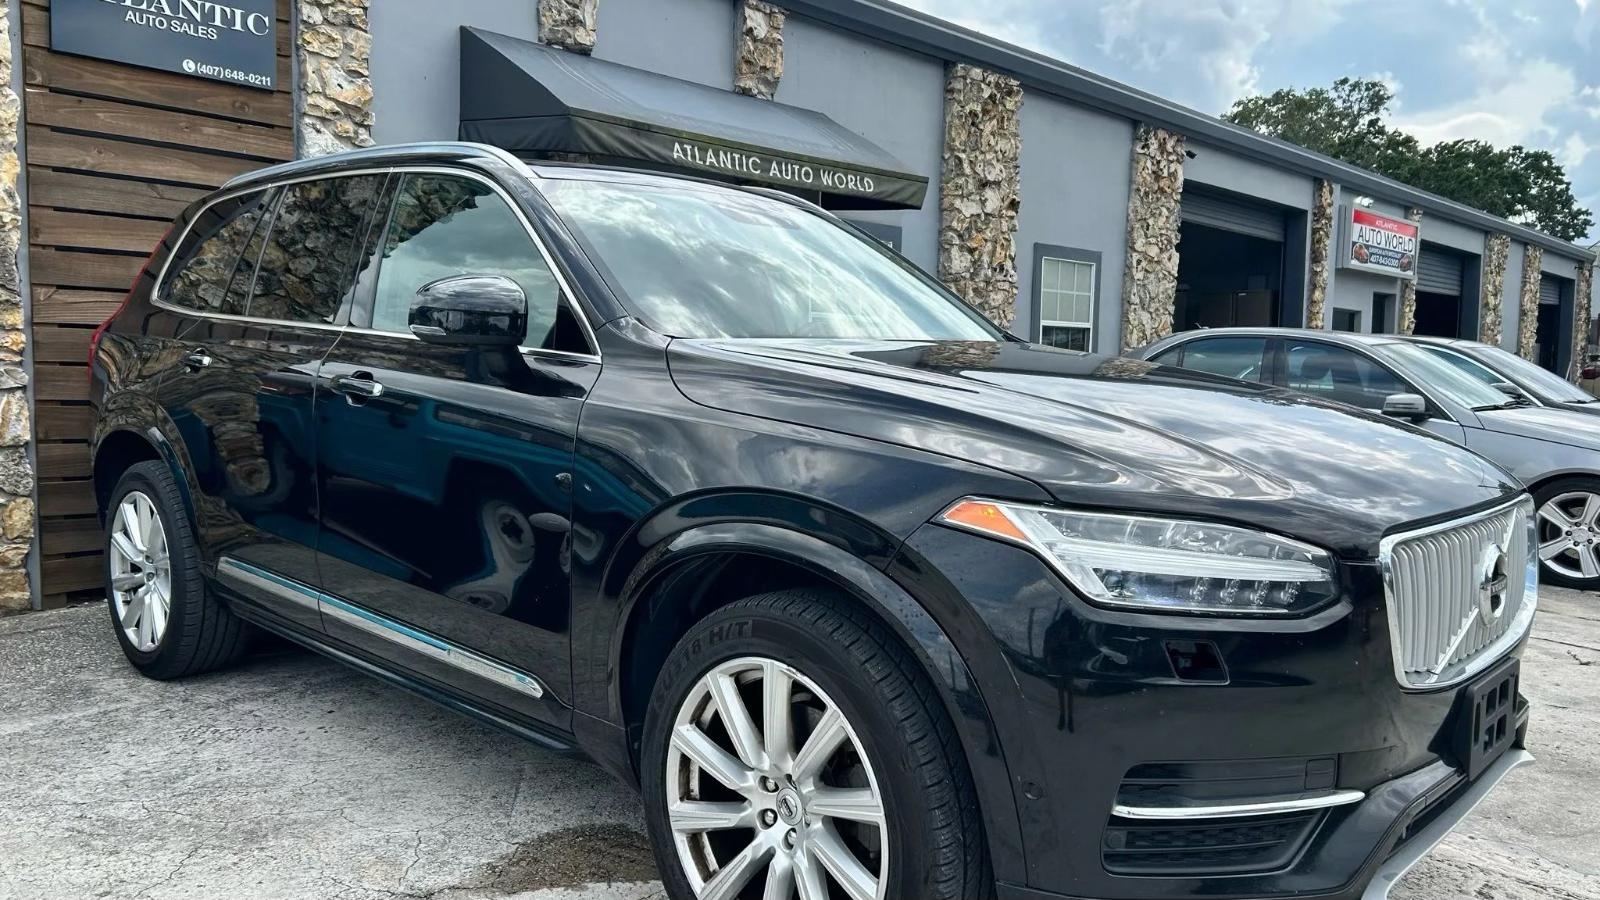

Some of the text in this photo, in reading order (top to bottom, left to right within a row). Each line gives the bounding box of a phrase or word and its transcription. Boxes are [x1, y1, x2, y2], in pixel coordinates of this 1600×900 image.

[103, 0, 269, 36] ANTIC
[125, 10, 218, 40] AUTO SALES
[673, 141, 875, 193] ATLANTIC AUTO WORLD
[1358, 226, 1414, 253] AUTO WORLD
[1375, 219, 1398, 230] ATLANTIC
